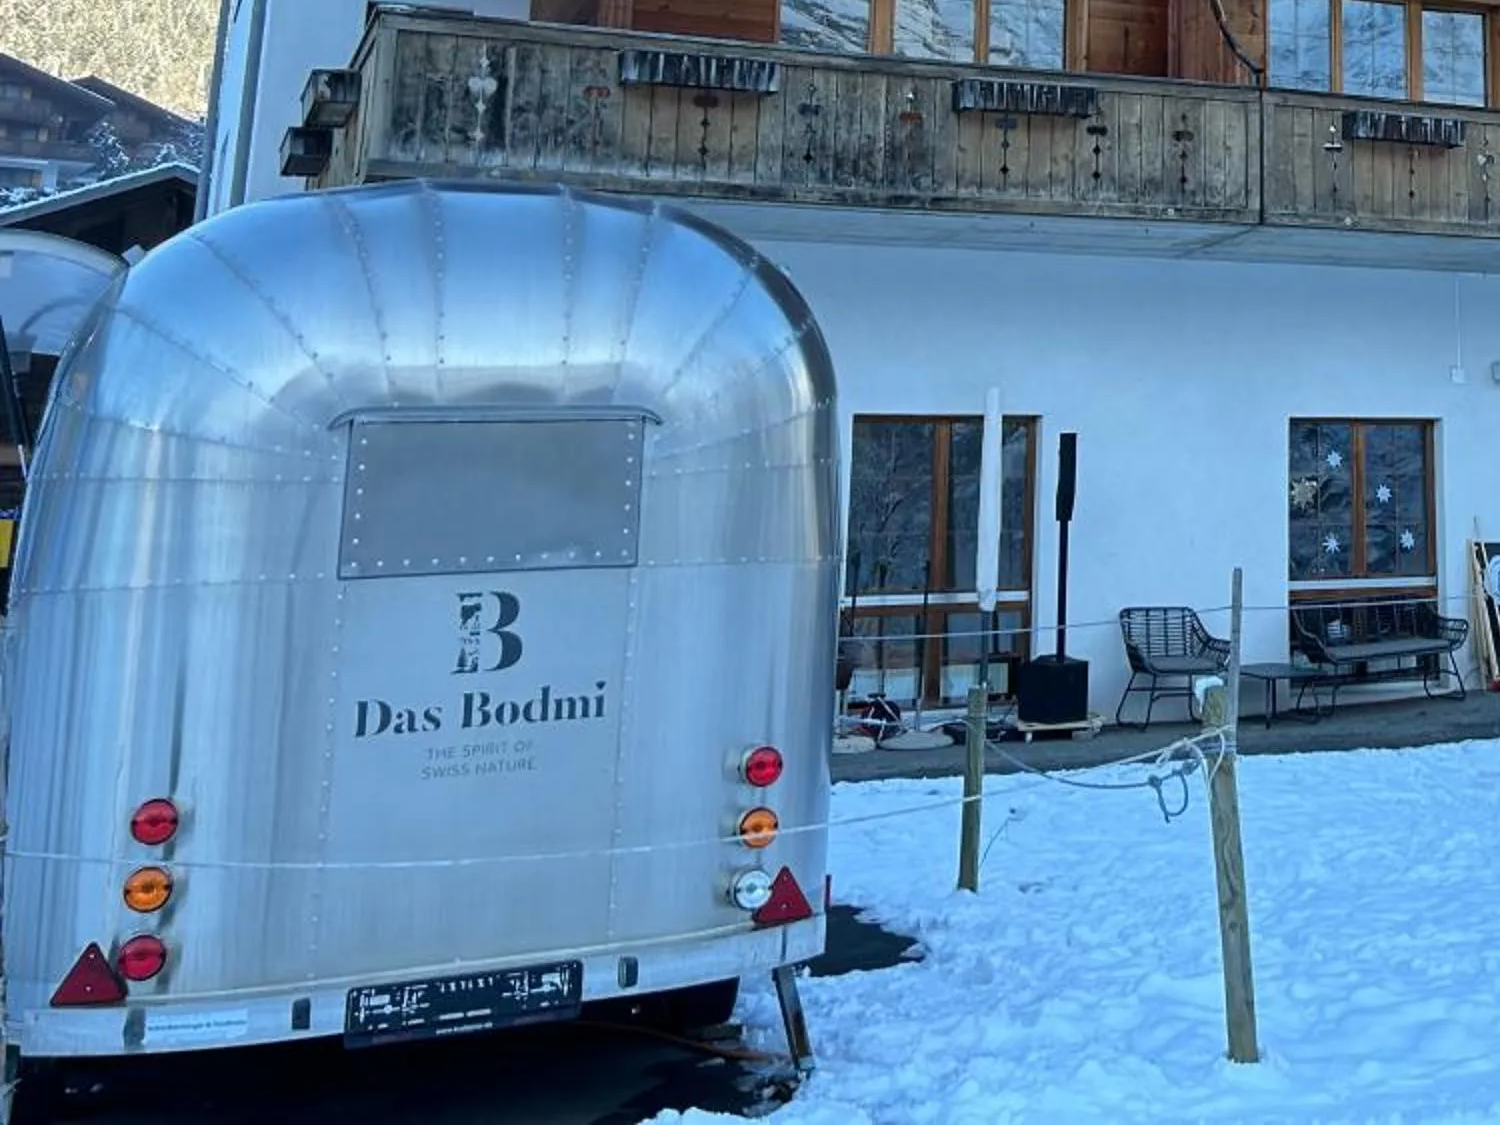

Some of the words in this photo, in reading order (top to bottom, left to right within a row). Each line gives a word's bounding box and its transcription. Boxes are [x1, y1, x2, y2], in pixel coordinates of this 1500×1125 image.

[451, 590, 524, 675] B
[354, 698, 443, 738] Das
[460, 680, 606, 729] Bodmi
[420, 762, 471, 780] SWISS
[474, 756, 537, 776] NATURE
[424, 745, 457, 760] THE
[463, 740, 508, 758] SPIRIT
[513, 738, 535, 754] OF
